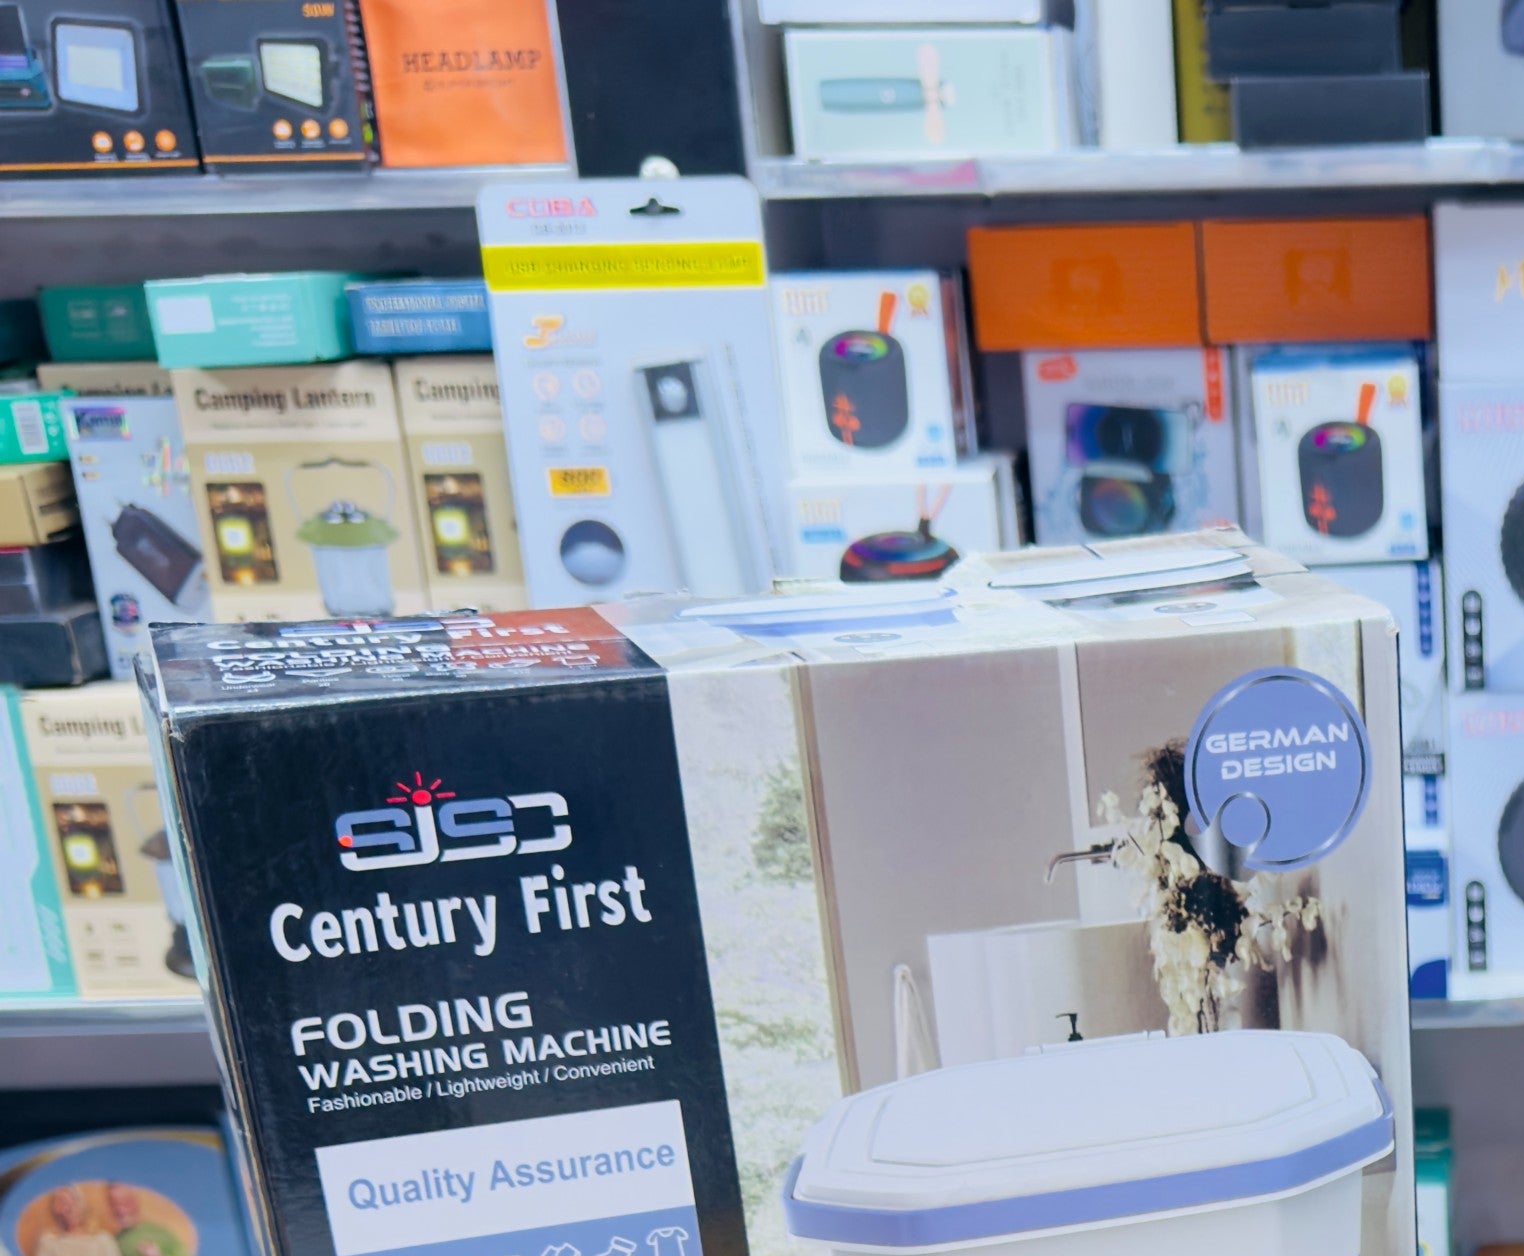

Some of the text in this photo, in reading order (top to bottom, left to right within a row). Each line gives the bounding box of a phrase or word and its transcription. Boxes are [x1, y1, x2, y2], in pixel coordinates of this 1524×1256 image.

[402, 49, 541, 74] HEADLAMP
[194, 387, 287, 413] Camping
[293, 386, 375, 410] Lantern
[206, 623, 570, 650] Century First
[212, 644, 451, 663] FOLDING
[39, 716, 125, 737] Camping
[1205, 722, 1349, 755] GERMAN
[1221, 749, 1337, 781] DESIGN
[270, 864, 653, 963] Century First
[291, 992, 534, 1056] FOLDING
[298, 1020, 672, 1092] WASHING MACHINE
[307, 1083, 423, 1114] Fashionable
[436, 1067, 541, 1099] Lightweight
[554, 1056, 656, 1082] Convenient
[348, 1139, 676, 1212] Quality Assurance
